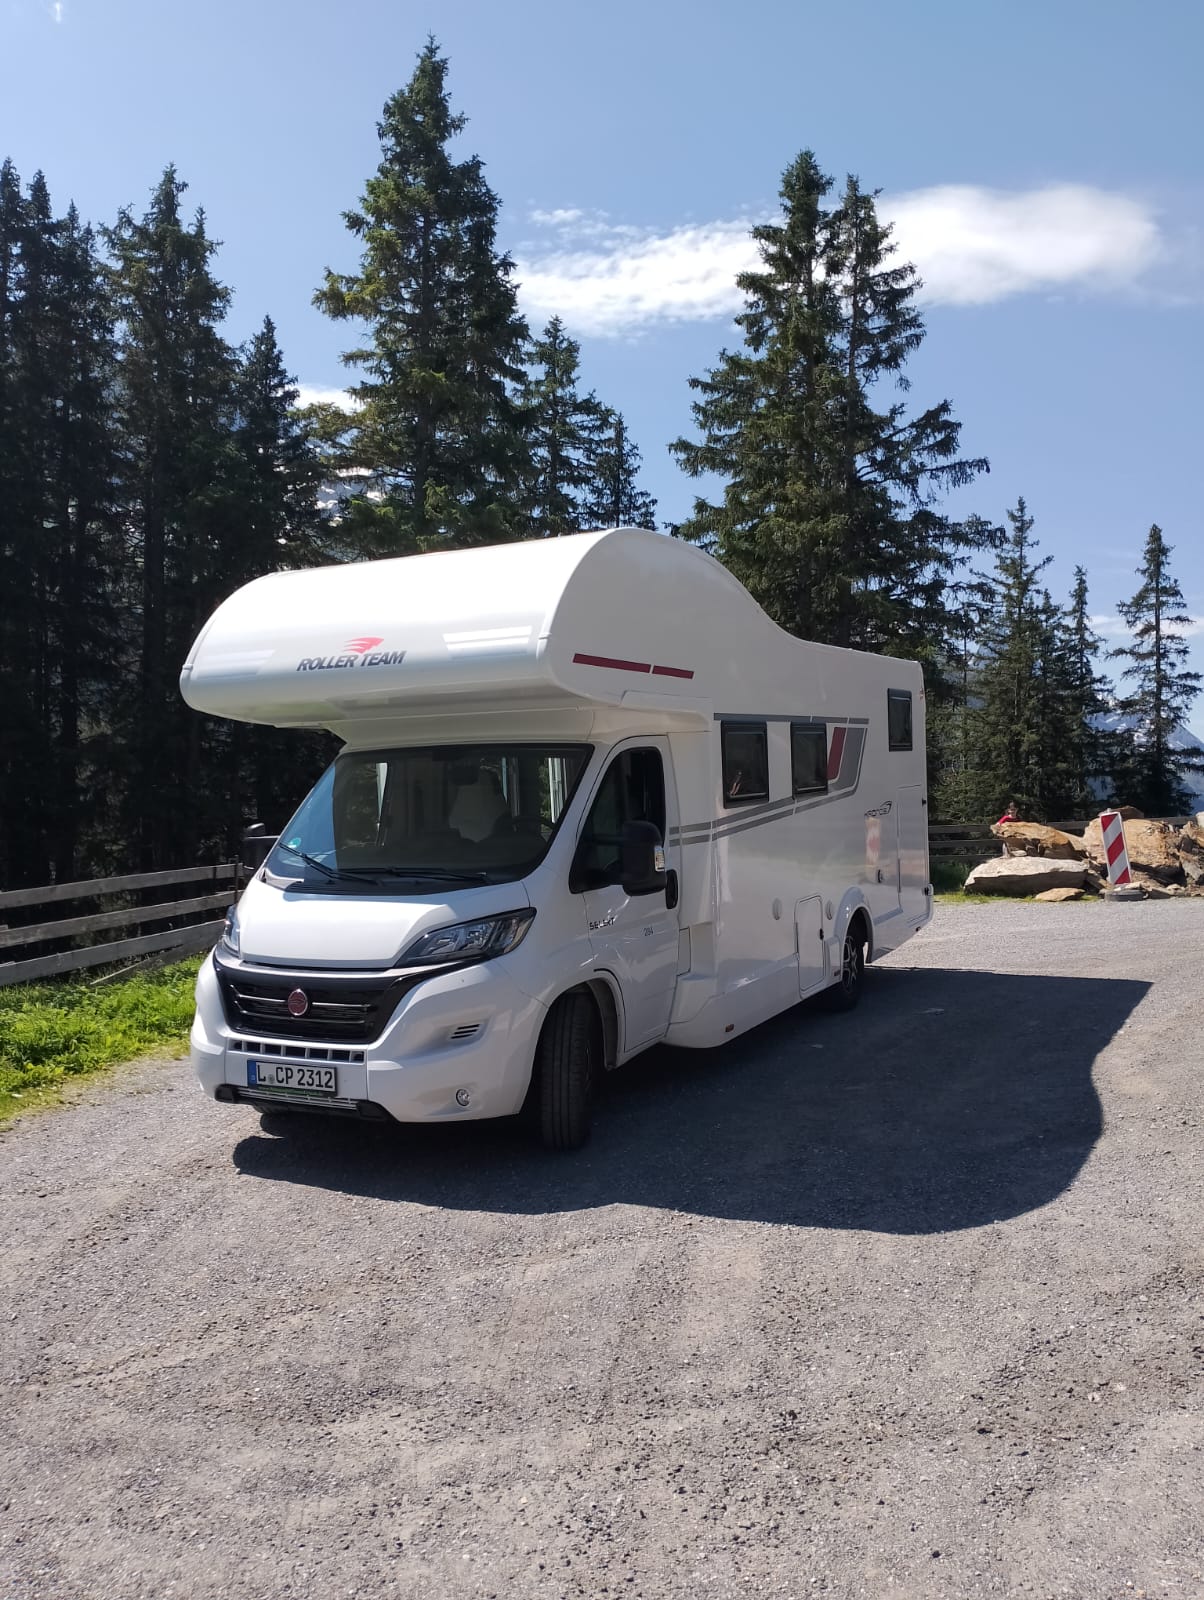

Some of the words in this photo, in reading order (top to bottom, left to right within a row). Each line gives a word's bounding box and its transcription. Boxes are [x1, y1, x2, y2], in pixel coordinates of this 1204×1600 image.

[296, 654, 358, 671] ROLLER
[360, 650, 407, 667] TEAM
[257, 1064, 266, 1082] L
[276, 1066, 294, 1084] CP
[297, 1068, 333, 1088] 2312
